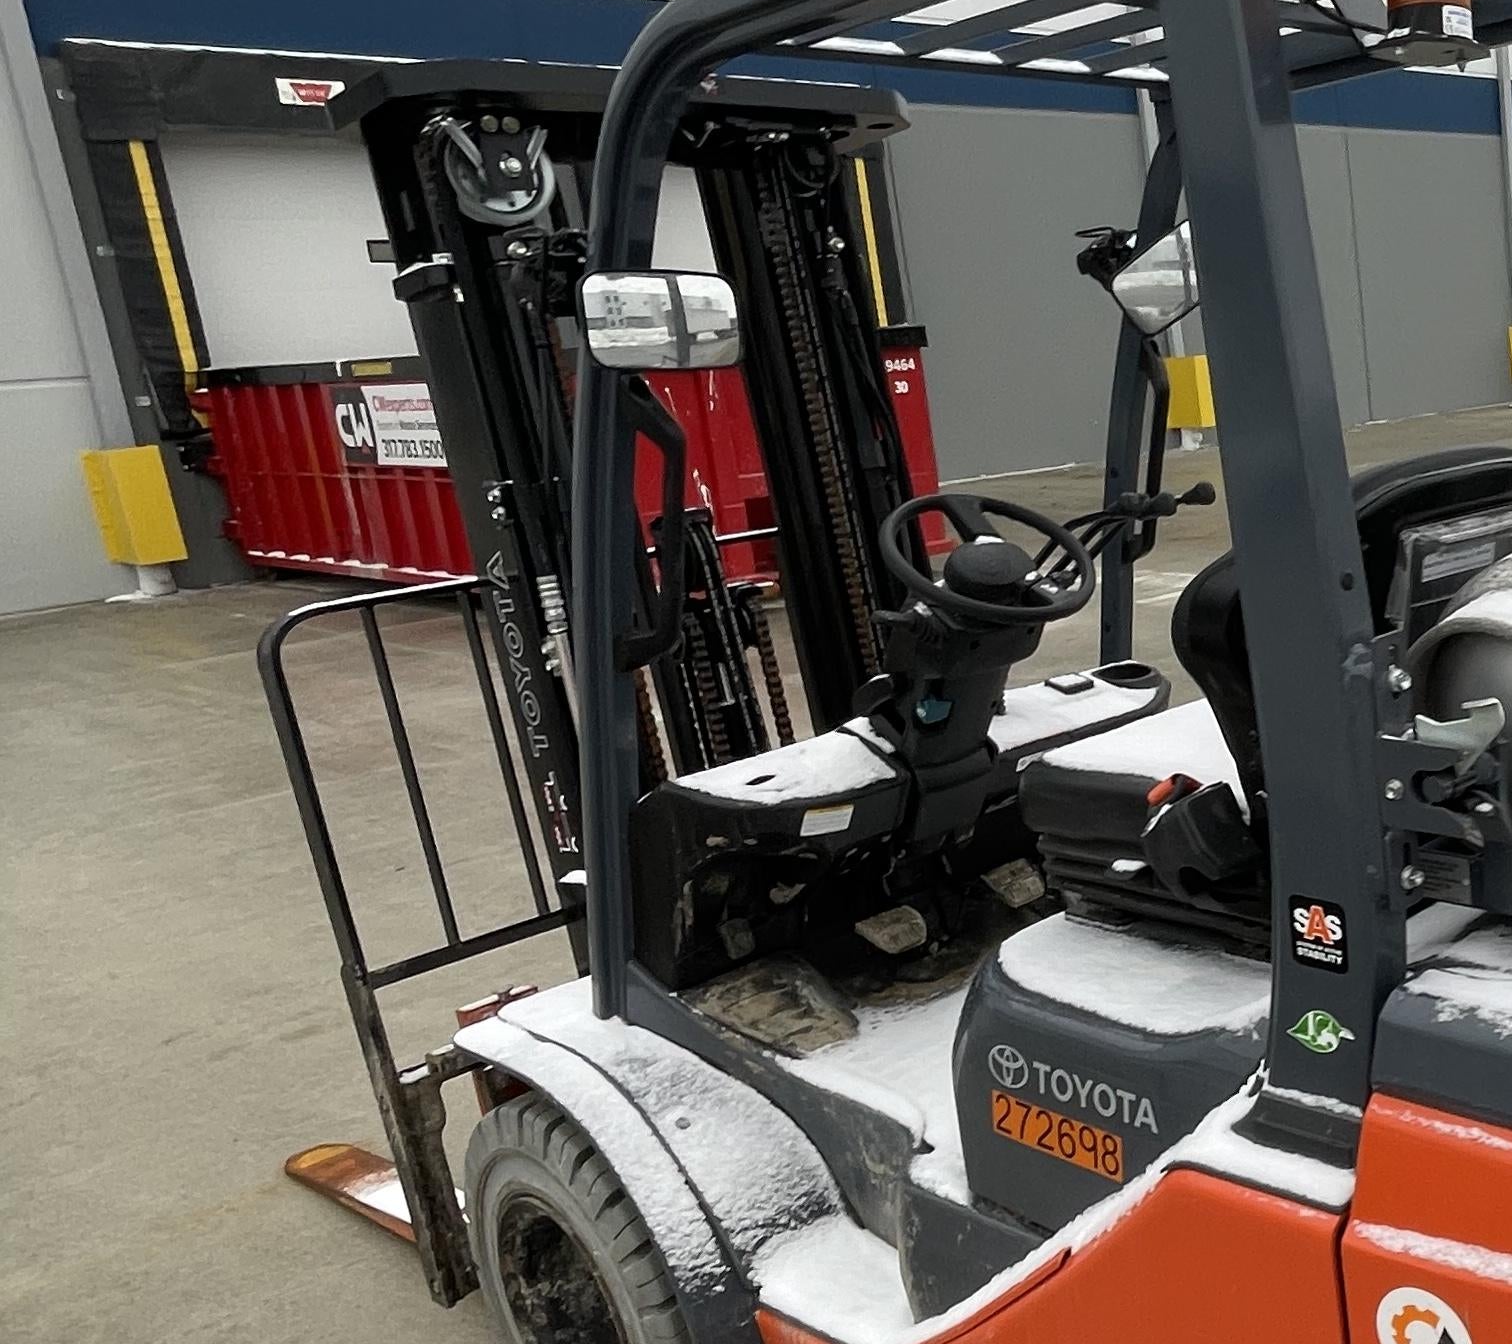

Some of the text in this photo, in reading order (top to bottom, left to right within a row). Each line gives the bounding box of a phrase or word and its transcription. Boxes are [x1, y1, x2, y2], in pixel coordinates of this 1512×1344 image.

[885, 358, 915, 372] 9464
[894, 381, 909, 394] 30
[335, 402, 374, 447] CW
[486, 550, 549, 758] TOYOTA
[1293, 905, 1343, 945] SAS
[1296, 946, 1343, 965] STABILITY
[1032, 1061, 1159, 1134] TOYOTA
[995, 1094, 1120, 1176] 272698
